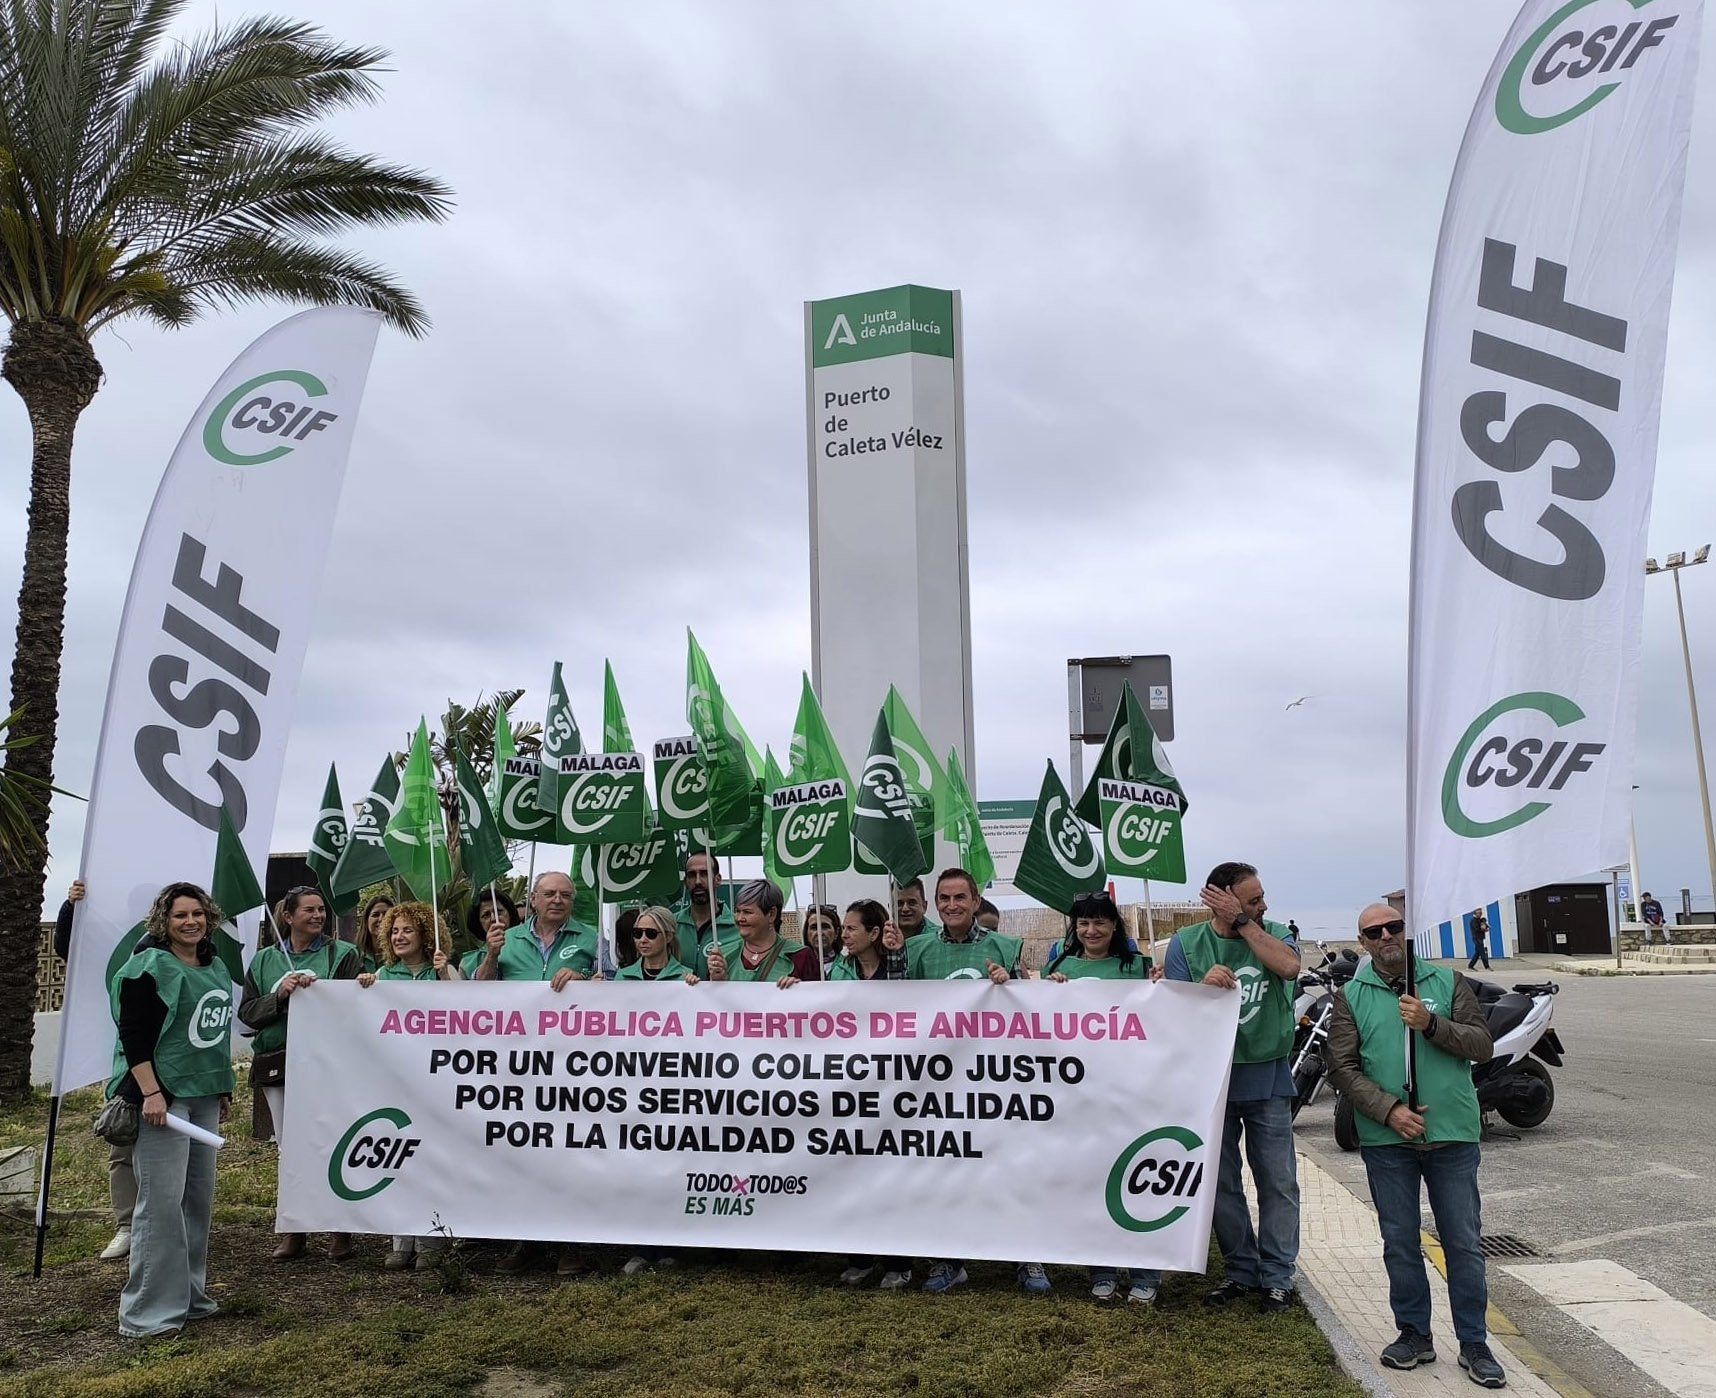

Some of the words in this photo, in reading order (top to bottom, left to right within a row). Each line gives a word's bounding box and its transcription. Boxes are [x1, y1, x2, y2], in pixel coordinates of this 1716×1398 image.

[1531, 14, 1680, 86] CSIF
[861, 309, 897, 326] Junta
[861, 326, 876, 339] de
[879, 319, 941, 337] Andalucía
[824, 386, 890, 409] Puerto
[231, 397, 338, 441] CSIF
[824, 415, 849, 433] de
[1451, 236, 1628, 601] CSIF
[824, 437, 887, 458] Caleta
[891, 426, 943, 450] Vélez
[134, 531, 280, 834] CSIF
[546, 707, 576, 752] CSI
[561, 754, 641, 771] MÁLAGA
[655, 739, 697, 758] MÁL
[506, 759, 541, 776] MÁL
[1465, 737, 1606, 791] CSIF
[675, 768, 707, 795] CS
[773, 782, 844, 807] MÁLAGA
[863, 769, 913, 821] CSIF
[1102, 783, 1177, 808] MÁLAGA
[576, 786, 633, 810] CSIF
[322, 820, 348, 854] CS
[788, 811, 838, 841] CSIF
[1058, 807, 1084, 859] CSI
[1121, 815, 1172, 844] CSIF
[611, 839, 666, 869] CSIF
[1241, 981, 1269, 1005] SIF
[380, 1009, 526, 1036] AGENCIA
[538, 1004, 684, 1037] PÚBLICA
[696, 1011, 858, 1039] PUERTOS
[869, 1011, 917, 1039] DE
[929, 1006, 1147, 1041] ANDALUCÍA
[429, 1049, 497, 1075] POR
[509, 1050, 554, 1076] UN
[566, 1051, 739, 1079] CONVENIO
[751, 1053, 953, 1082] COLECTIVO
[966, 1054, 1085, 1085] JUSTO
[455, 1085, 523, 1111] POR
[535, 1086, 627, 1113] UNOS
[638, 1088, 820, 1117] SERVICIOS
[832, 1091, 880, 1118] DE
[893, 1092, 1055, 1121] CALIDAD
[347, 1136, 421, 1169] CSIF
[485, 1121, 553, 1148] POR
[565, 1122, 606, 1149] LA
[619, 1124, 795, 1153] IGUALDAD
[807, 1128, 982, 1158] SALARIAL
[685, 1196, 707, 1214] ES
[712, 1193, 755, 1215] MÁS
